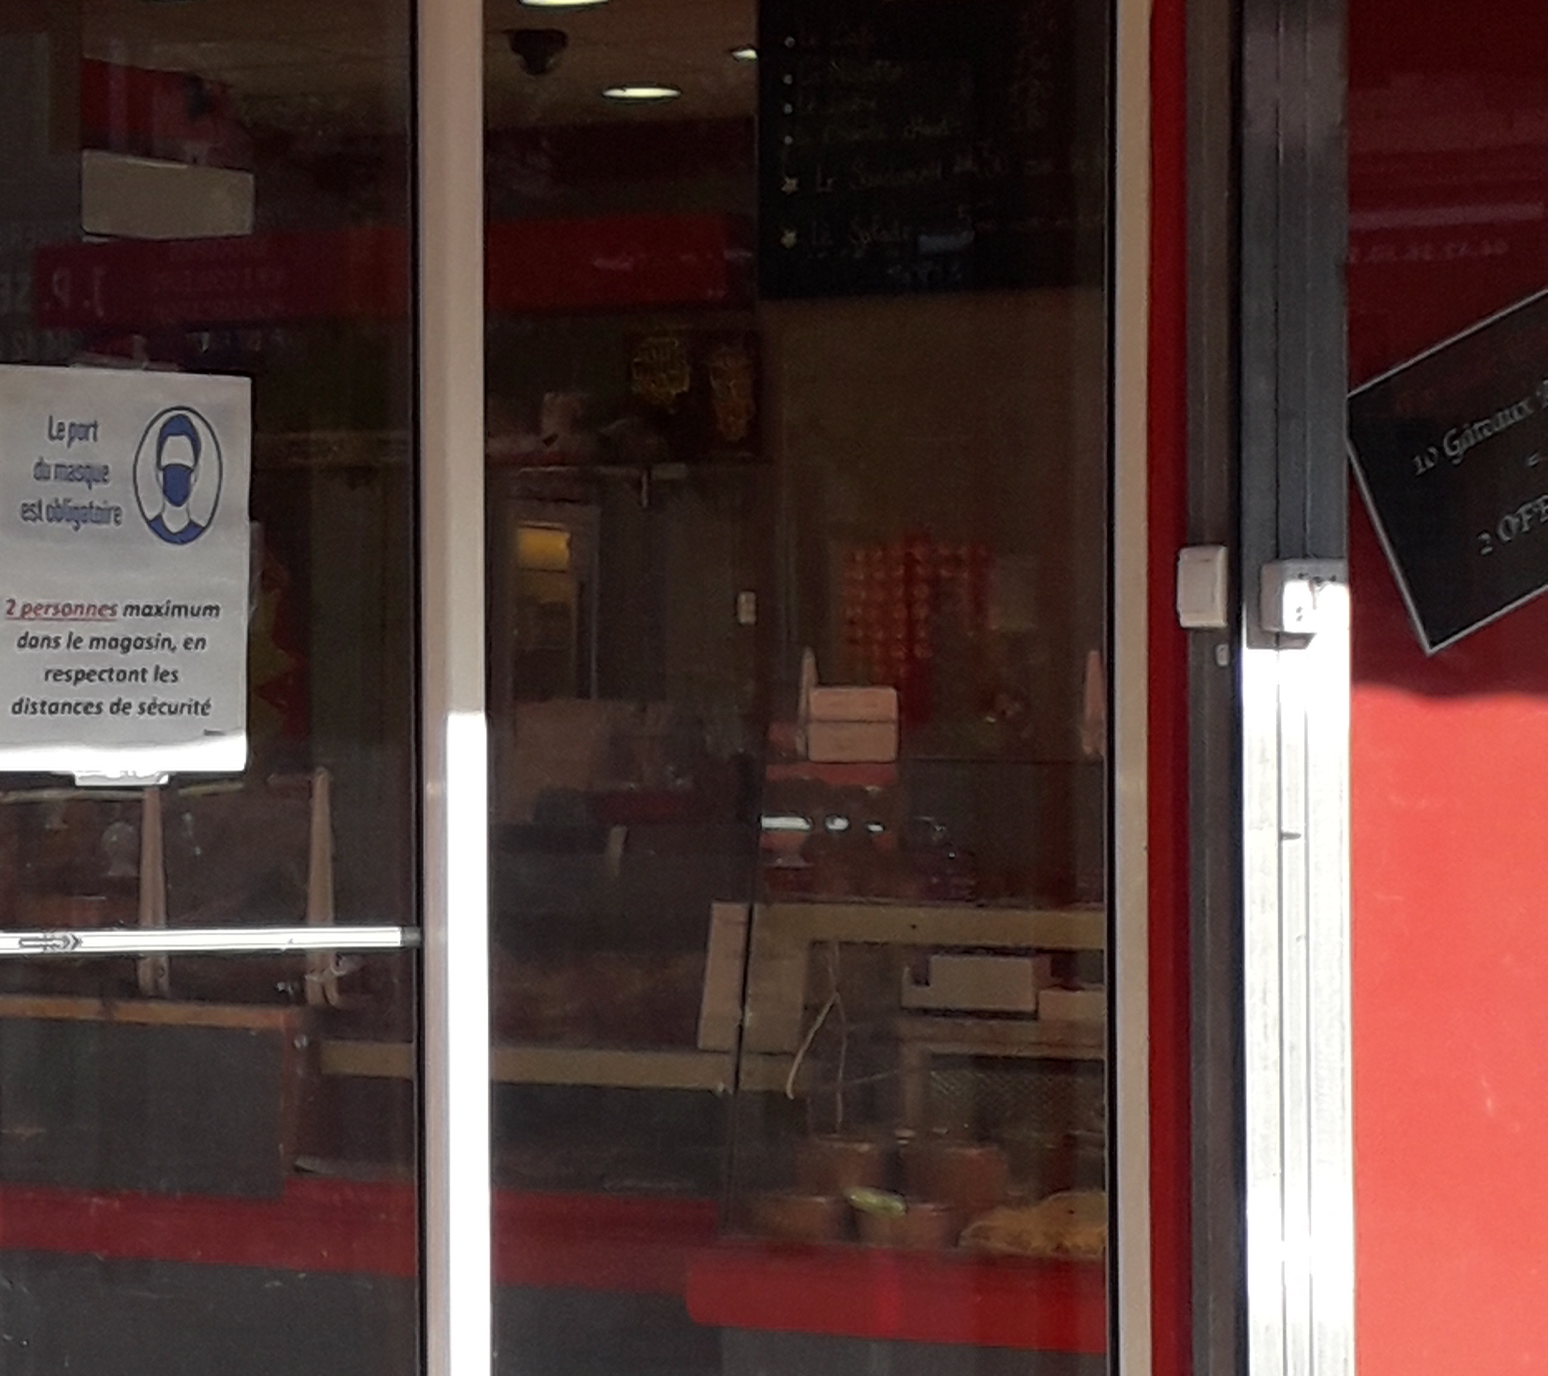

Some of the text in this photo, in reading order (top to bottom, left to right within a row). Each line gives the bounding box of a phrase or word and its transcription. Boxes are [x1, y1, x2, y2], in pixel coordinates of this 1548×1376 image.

[47, 414, 99, 449] Le port
[33, 456, 110, 491] du masque
[21, 498, 123, 532] est obligatoire
[6, 598, 221, 620] 2 personnes maximum
[17, 631, 208, 655] dans le magasin, en
[44, 665, 179, 686] respectant les
[11, 696, 213, 716] distances de sécurité
